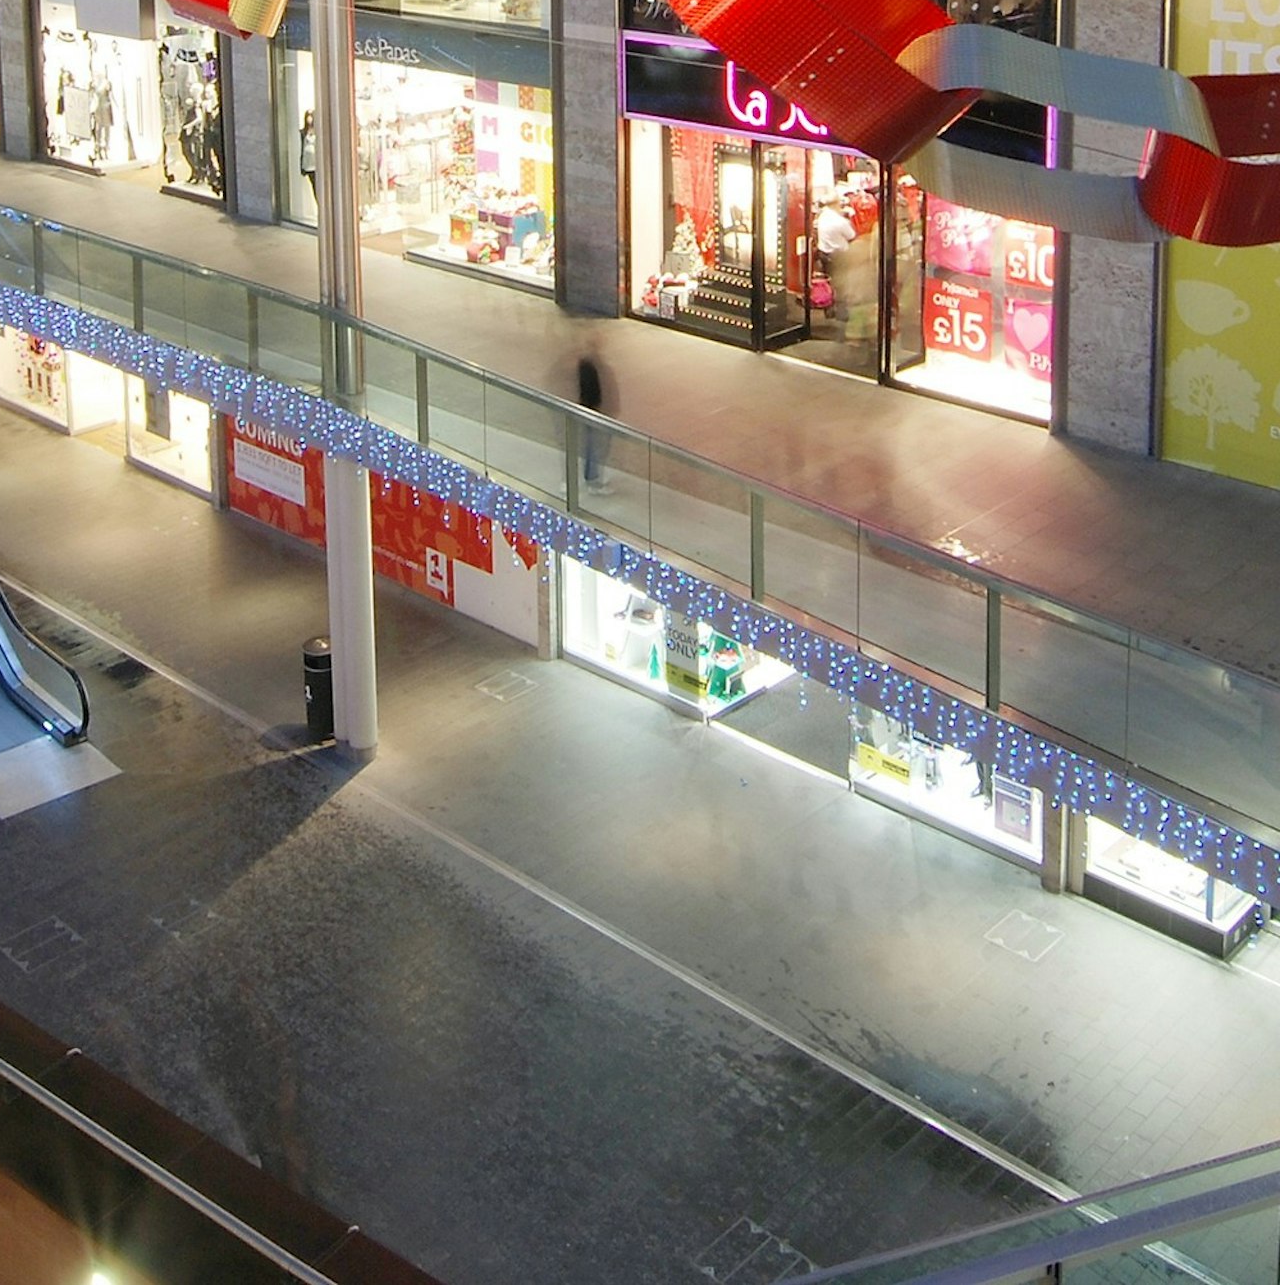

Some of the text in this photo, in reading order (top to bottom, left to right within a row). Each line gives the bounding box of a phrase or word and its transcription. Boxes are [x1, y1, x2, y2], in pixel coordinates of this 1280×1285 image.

[932, 293, 961, 309] ONLY
[932, 309, 987, 352] £15
[666, 638, 699, 660] ONLY
